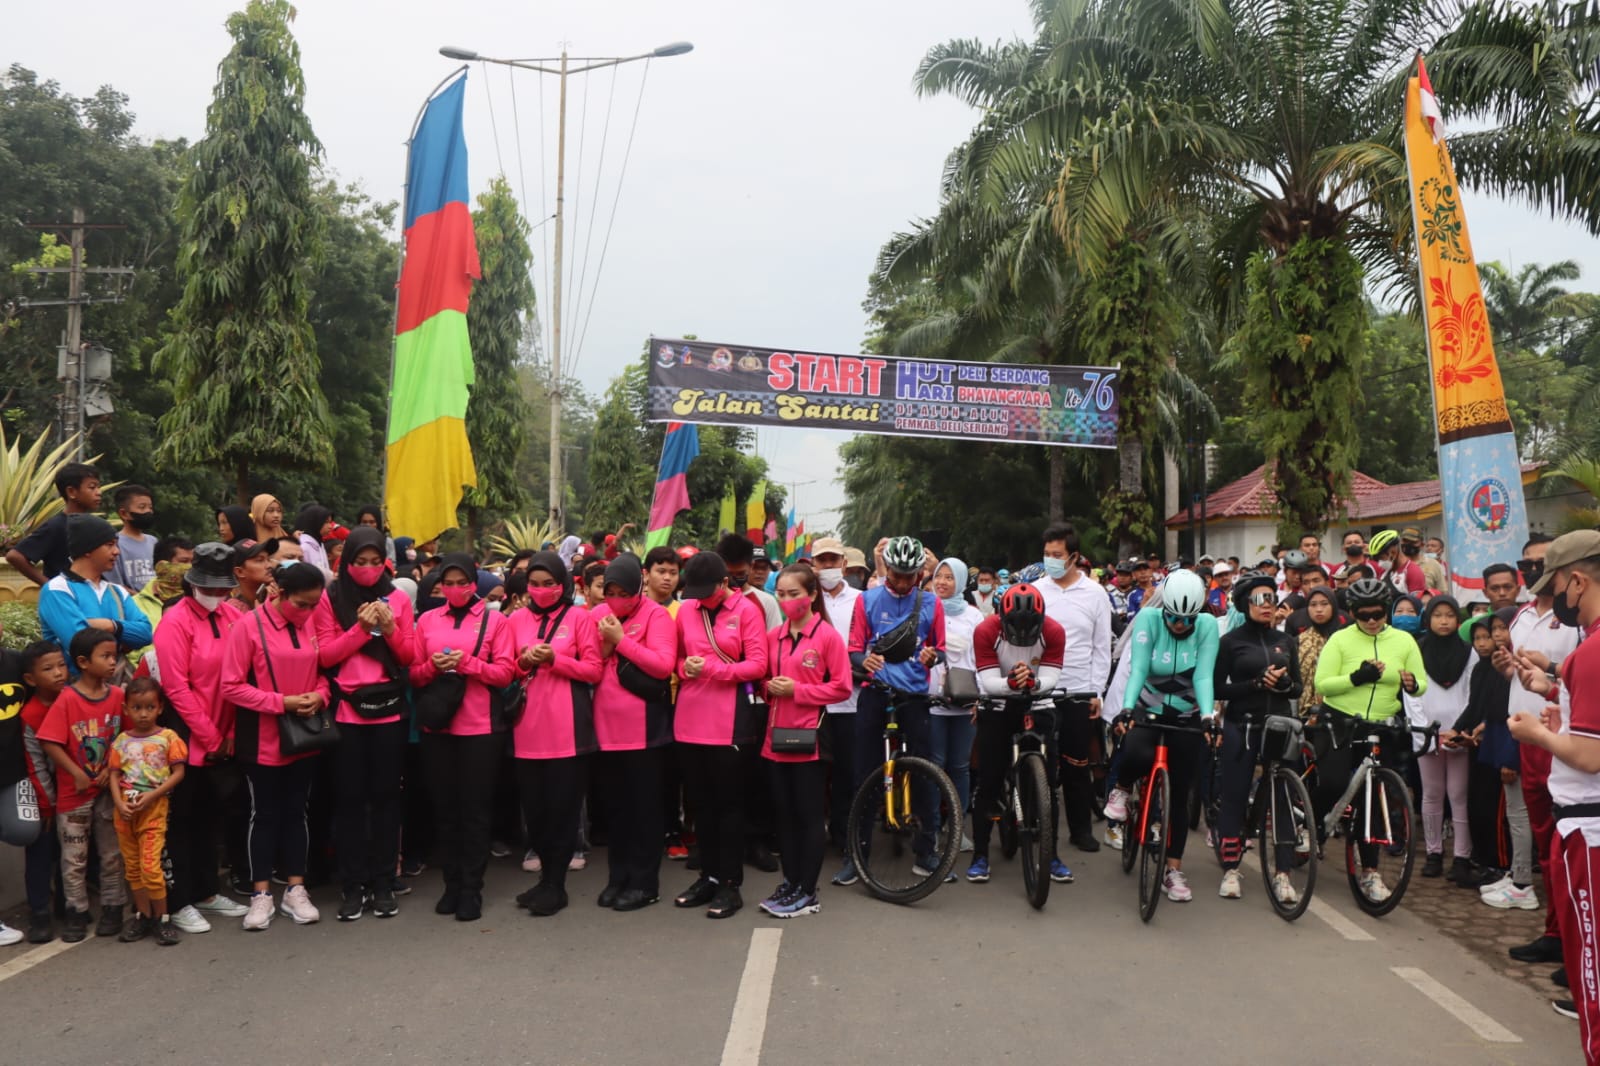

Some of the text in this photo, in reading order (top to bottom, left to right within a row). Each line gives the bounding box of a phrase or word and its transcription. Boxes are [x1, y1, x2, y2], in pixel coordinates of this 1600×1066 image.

[768, 352, 887, 396] START
[896, 361, 1050, 399] HUT DELI SERDANG
[672, 389, 881, 422] Jalan Santai
[896, 403, 912, 416] DI
[958, 386, 1052, 408] BHAYANGKARA
[940, 420, 961, 433] DELI
[963, 422, 1009, 436] SERDANG
[1578, 889, 1597, 1001] POLDA SUMUT
